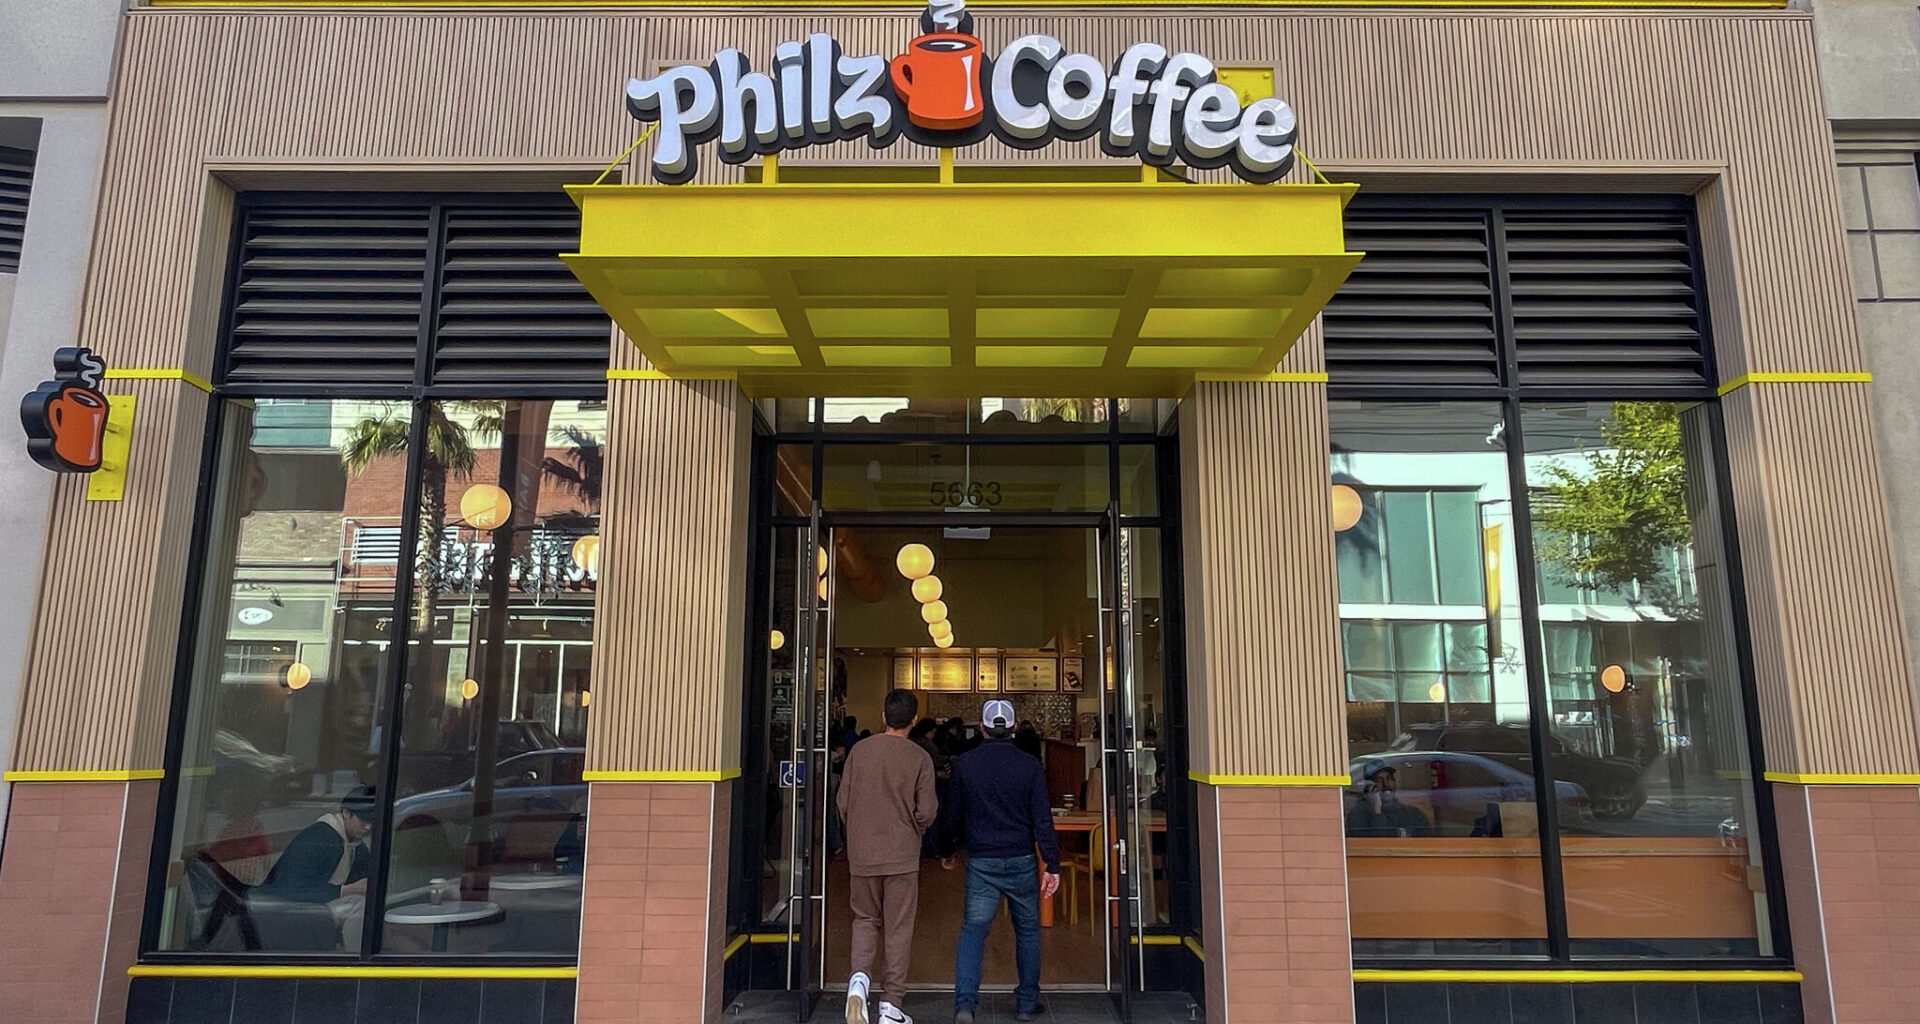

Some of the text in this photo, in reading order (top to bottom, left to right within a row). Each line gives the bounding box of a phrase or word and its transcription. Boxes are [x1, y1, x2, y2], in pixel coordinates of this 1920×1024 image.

[626, 32, 1297, 176] Philz Coffee
[930, 481, 1002, 507] 5663
